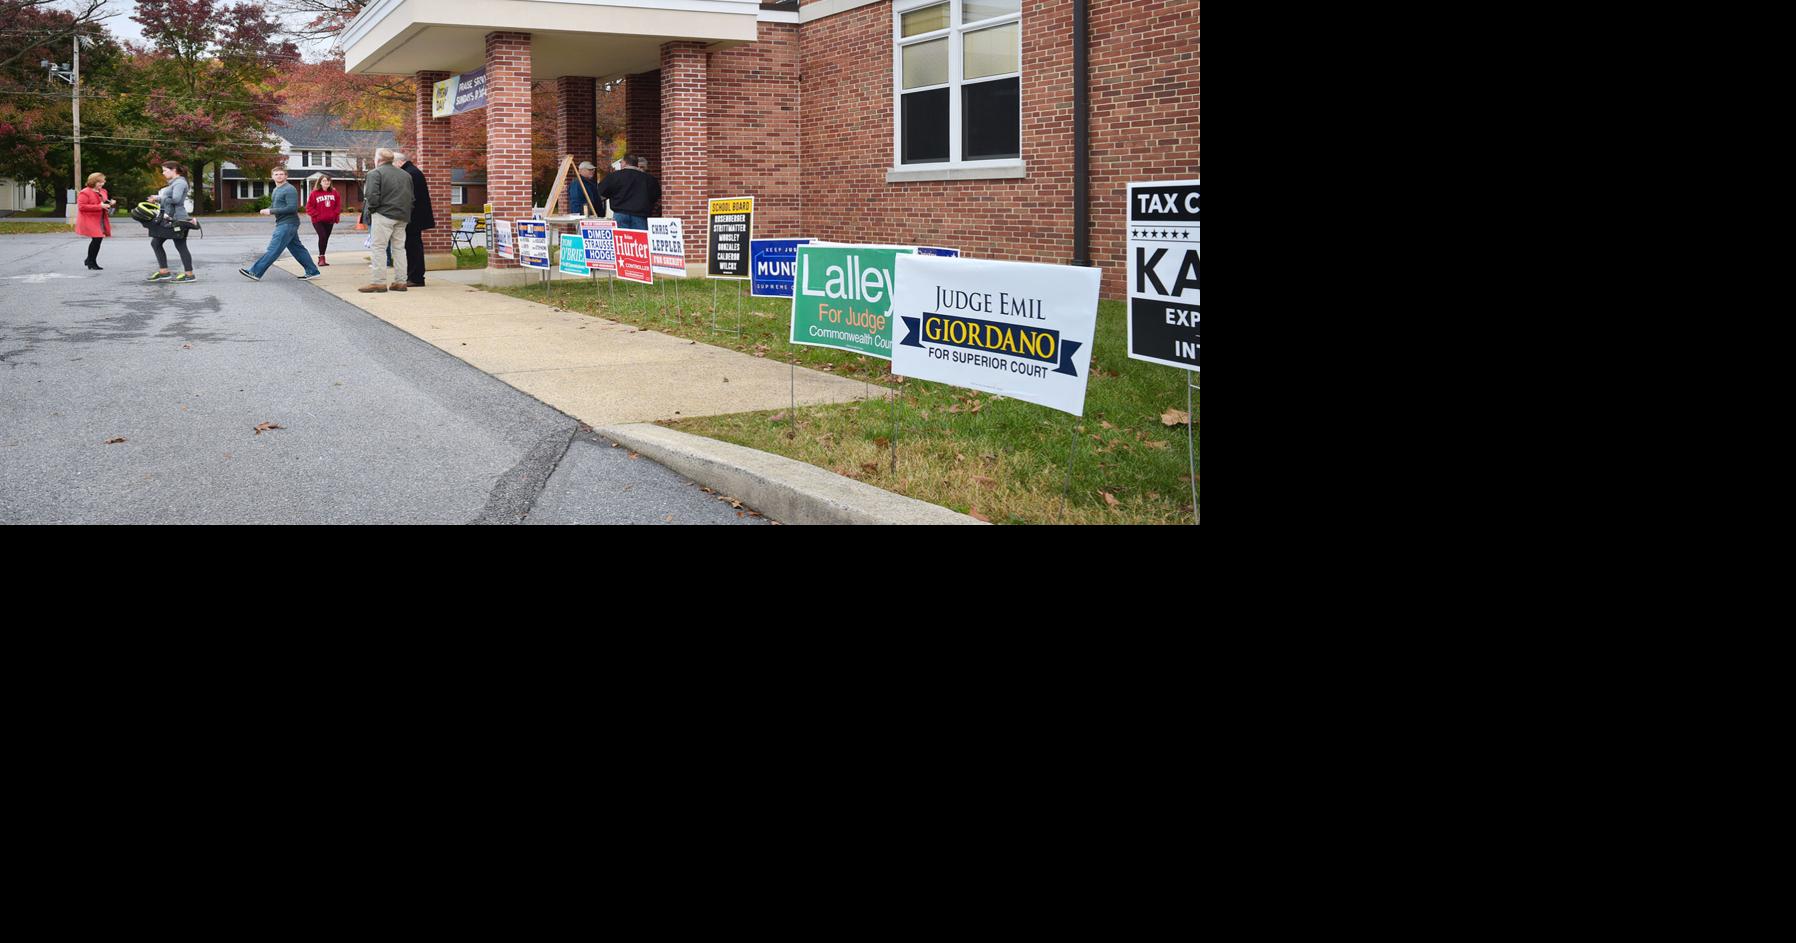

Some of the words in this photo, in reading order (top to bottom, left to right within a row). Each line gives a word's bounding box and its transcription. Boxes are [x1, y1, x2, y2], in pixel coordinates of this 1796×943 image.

[712, 202, 731, 212] SCHOOL
[733, 202, 749, 211] BOARD
[1138, 193, 1178, 214] TAX
[1184, 192, 1200, 214] C
[588, 230, 611, 239] DIMEO
[652, 225, 668, 234] CHRIS
[590, 250, 615, 260] HODGE
[615, 236, 648, 258] Hurter
[652, 240, 682, 252] LEPPLER
[1136, 247, 1200, 297] KA
[802, 254, 894, 317] Lalley
[935, 286, 992, 313] JUDGE
[1000, 292, 1046, 320] EMIL
[819, 304, 842, 322] For
[846, 308, 885, 334] Judge
[809, 325, 873, 345] Commonwealth
[925, 317, 1055, 359] GIORDANO
[928, 347, 950, 361] FOR
[952, 350, 1008, 370] SUPERIOR
[1012, 360, 1048, 379] COURT
